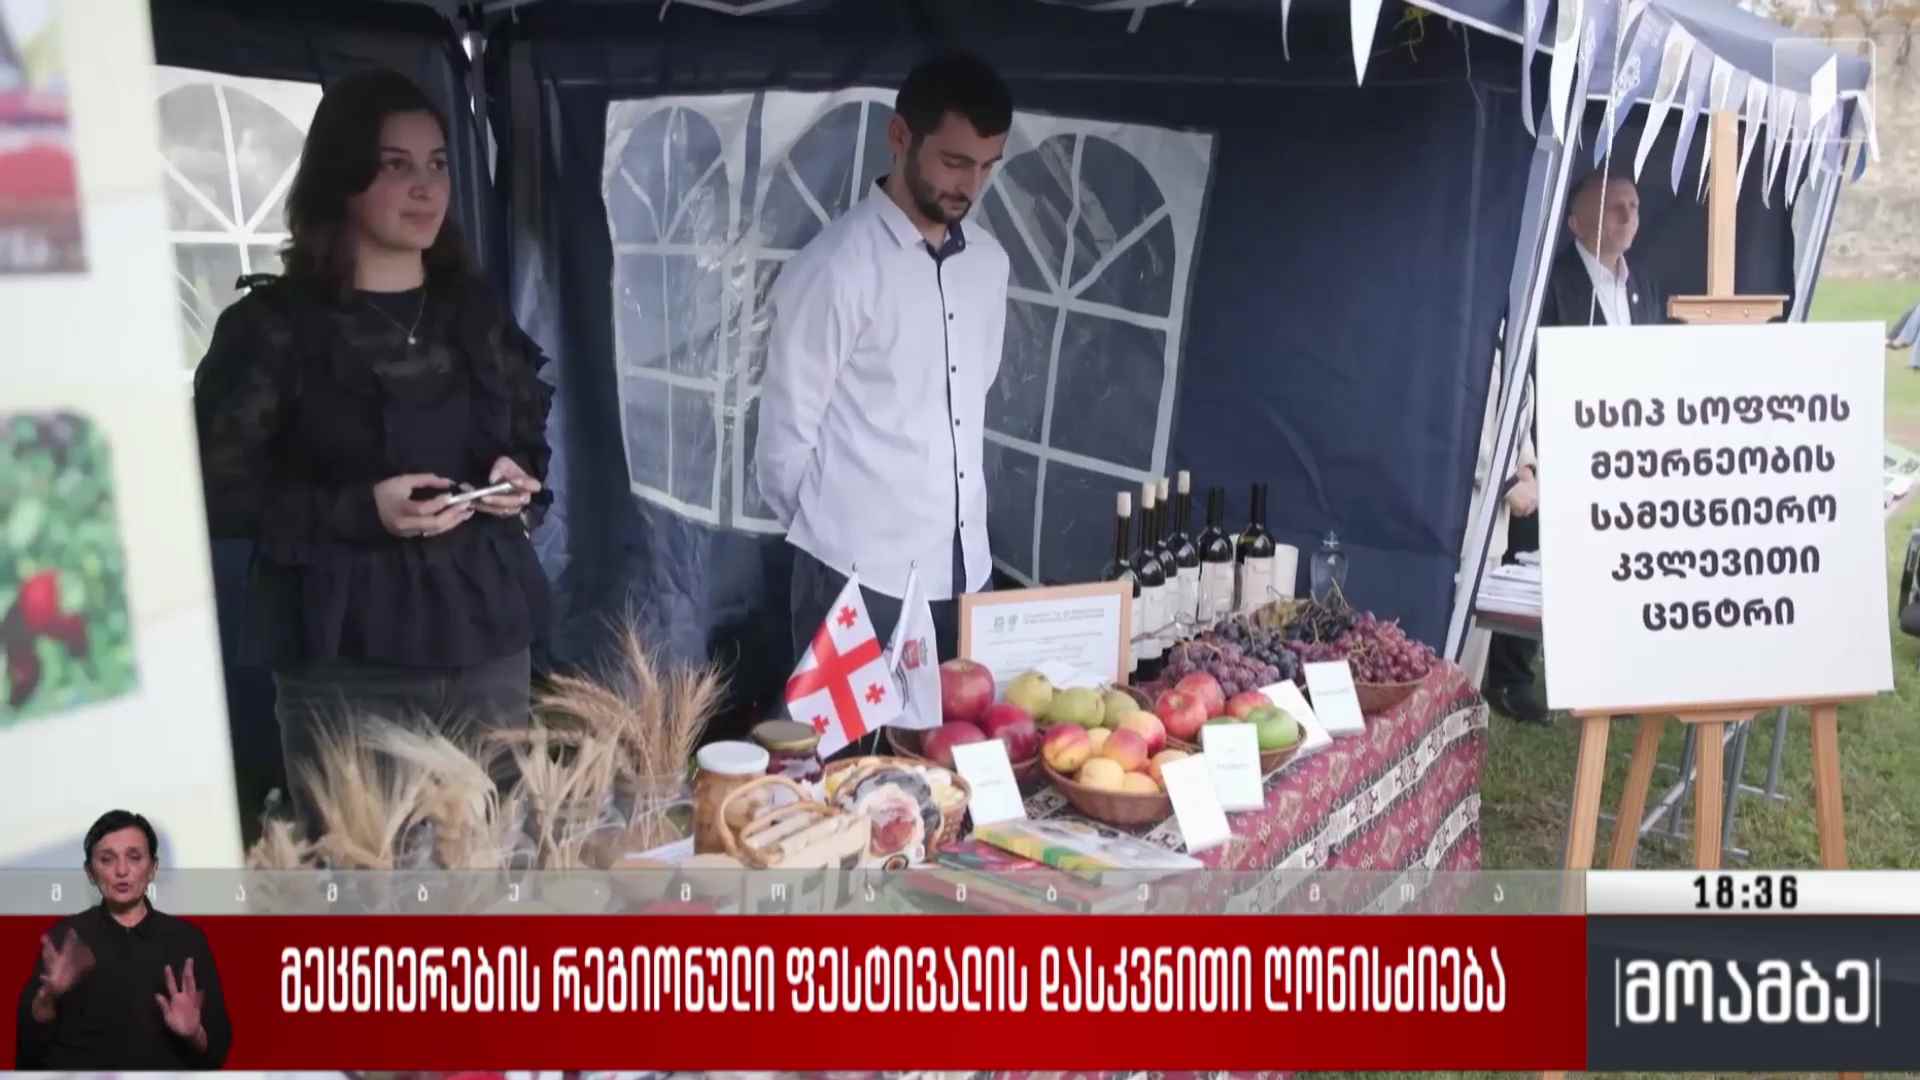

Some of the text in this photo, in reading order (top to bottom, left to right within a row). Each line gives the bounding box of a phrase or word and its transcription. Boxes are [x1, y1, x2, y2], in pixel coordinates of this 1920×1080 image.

[1574, 393, 1851, 428] სსიპ სოფლის
[1590, 444, 1836, 480] მეურნეობის
[1590, 493, 1838, 531] სამეცნიერო
[1610, 544, 1821, 582] კვლევითი
[1642, 595, 1796, 631] ცენტრი
